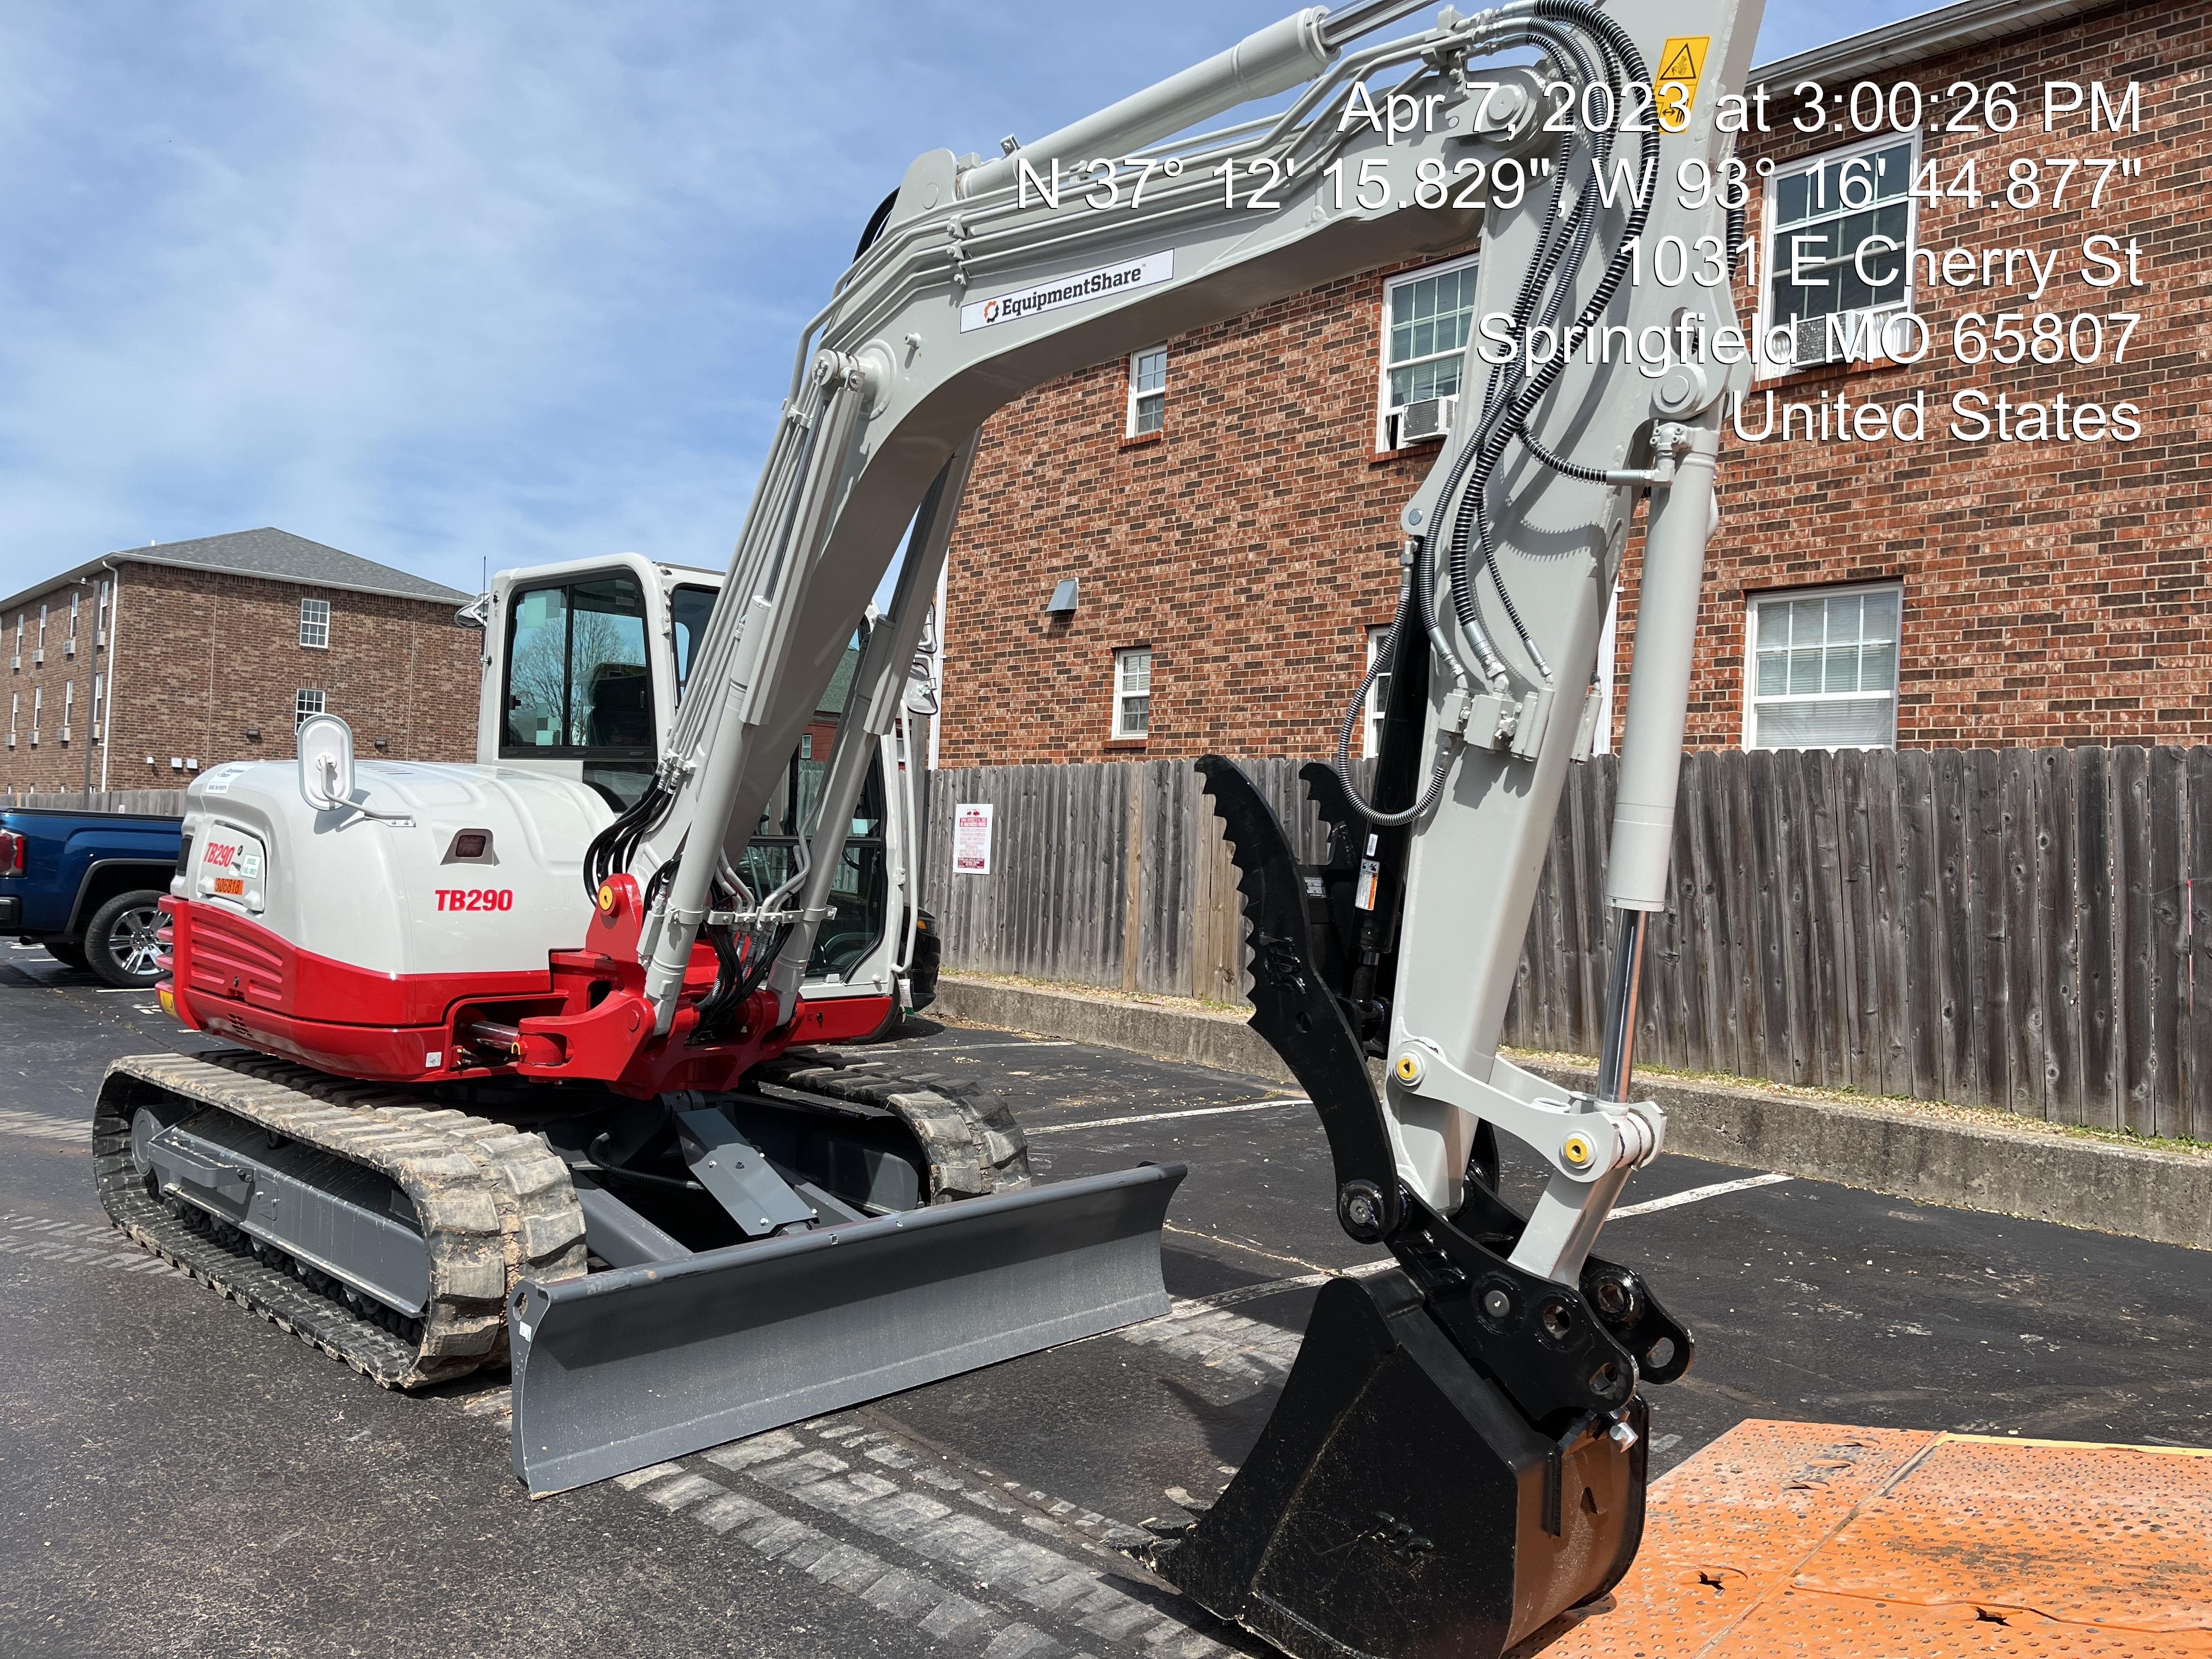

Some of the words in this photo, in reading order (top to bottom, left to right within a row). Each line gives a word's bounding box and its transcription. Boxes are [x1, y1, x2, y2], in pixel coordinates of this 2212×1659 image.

[1002, 268, 1141, 317] EquipmentShare
[204, 842, 235, 867] TB290
[215, 878, 241, 894] 306818
[435, 889, 513, 911] TB290
